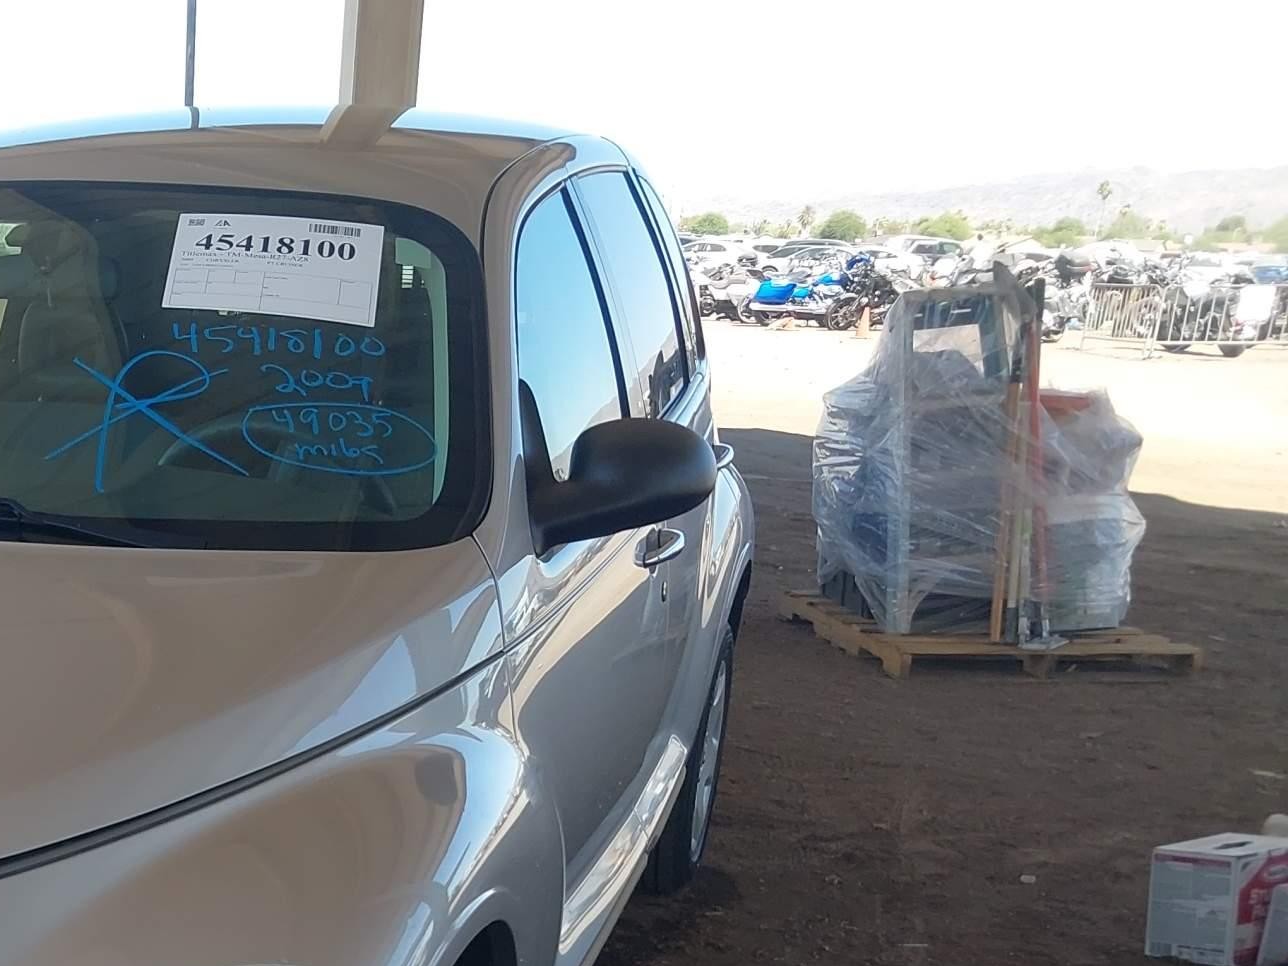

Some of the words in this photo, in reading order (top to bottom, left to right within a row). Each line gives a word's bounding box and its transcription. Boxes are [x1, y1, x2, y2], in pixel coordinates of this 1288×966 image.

[195, 233, 357, 261] 45418100
[172, 322, 386, 359] 45418100
[260, 364, 374, 402] 2009
